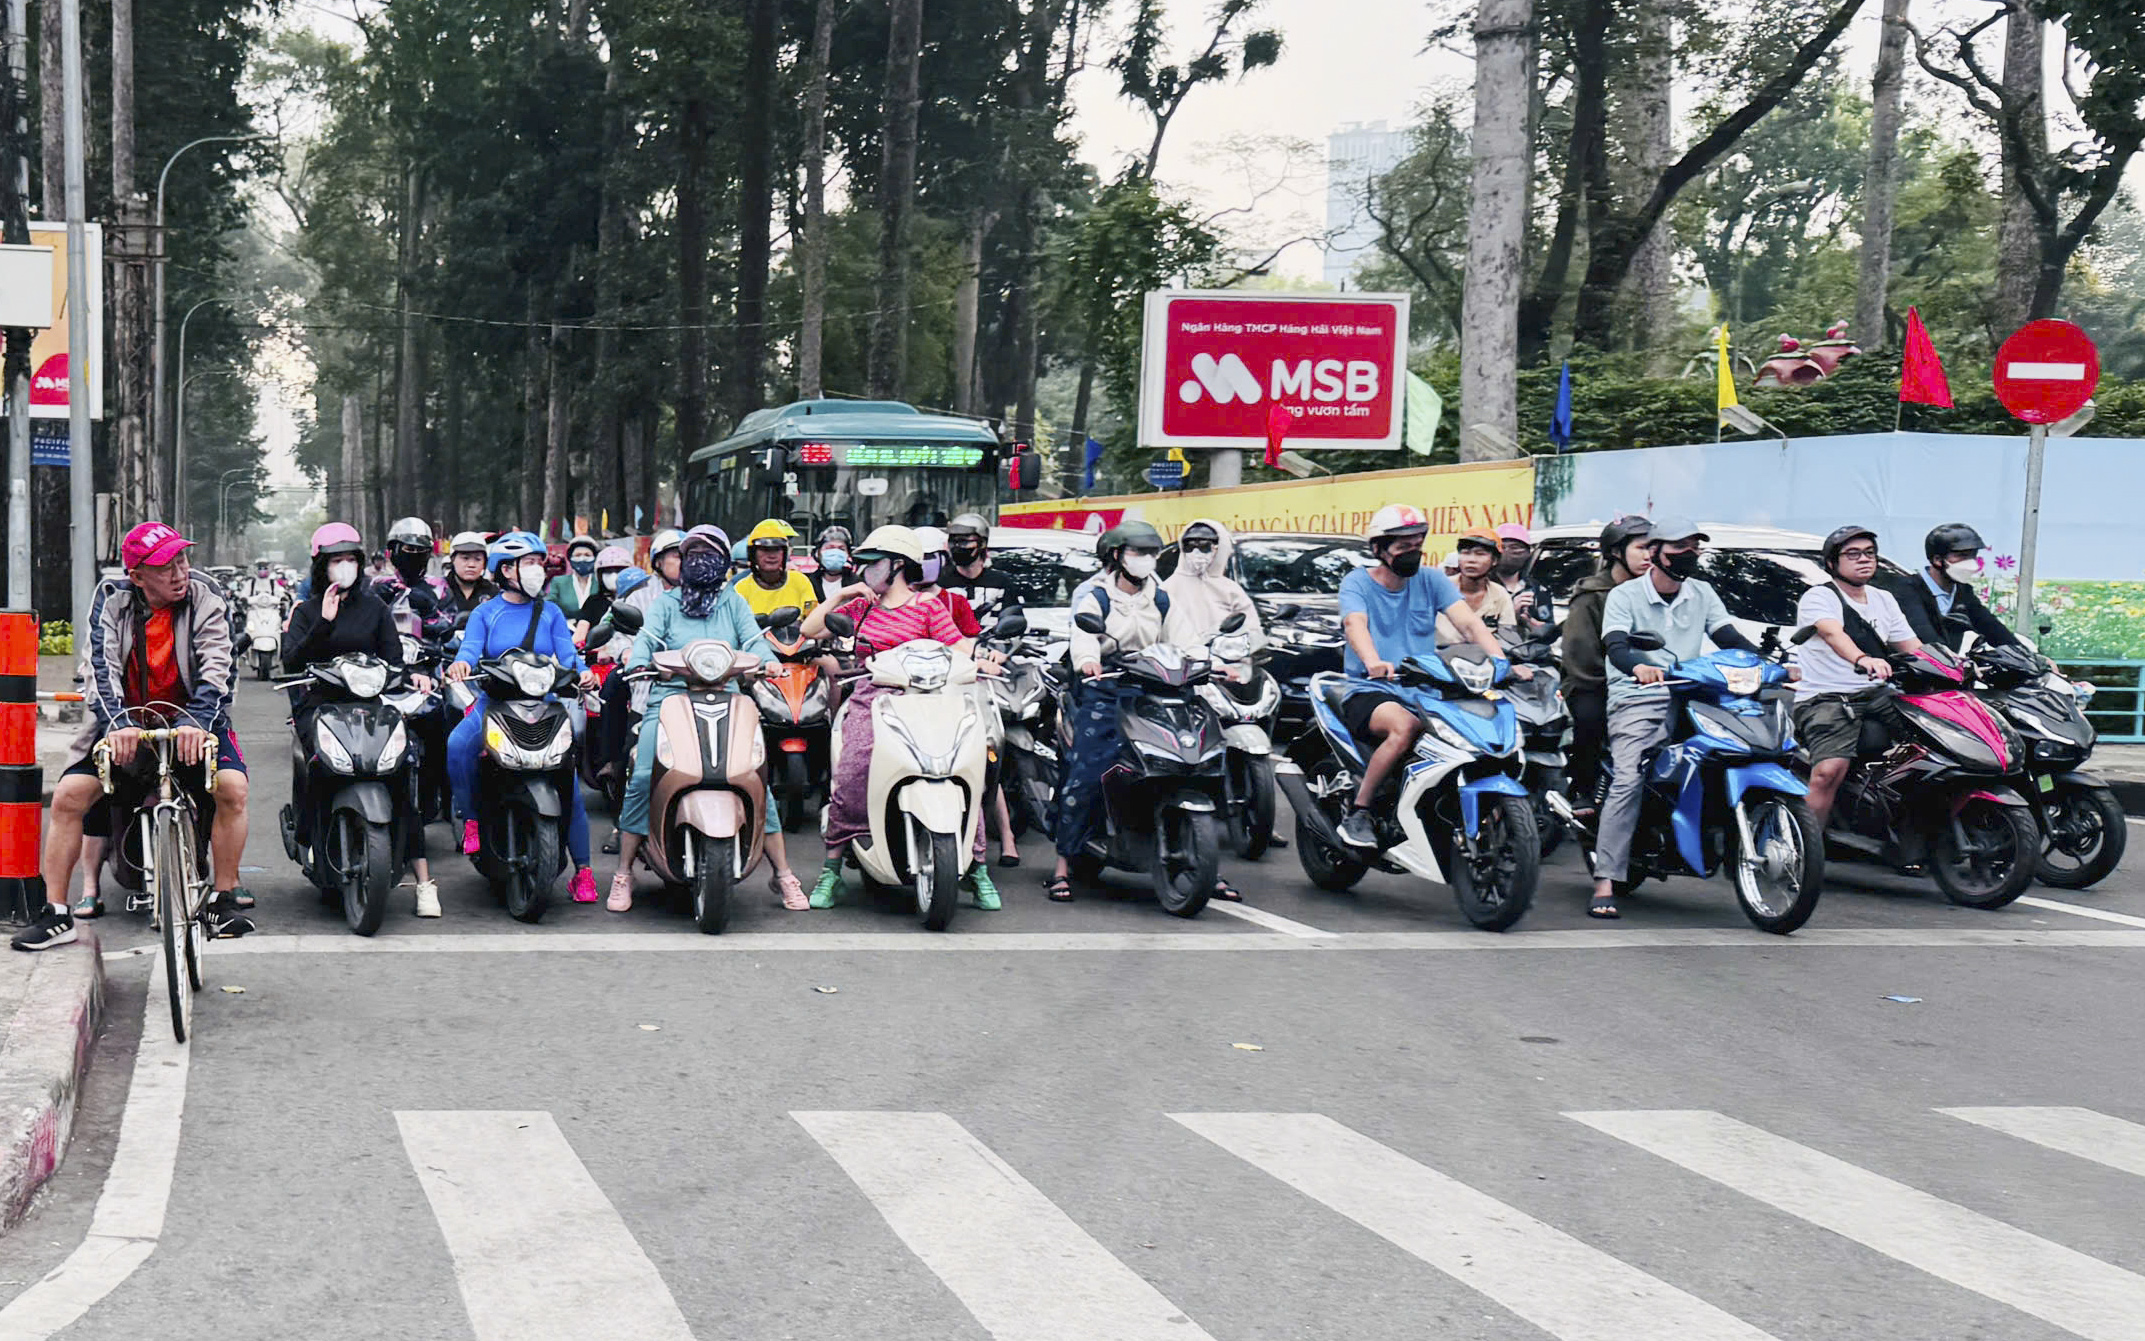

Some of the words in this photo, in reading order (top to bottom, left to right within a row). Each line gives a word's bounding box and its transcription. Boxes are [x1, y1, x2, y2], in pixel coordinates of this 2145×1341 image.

[1244, 323, 1277, 333] TMCP
[1356, 326, 1382, 335] Nam
[1271, 359, 1379, 401] MSB
[1482, 502, 1535, 530] NAM
